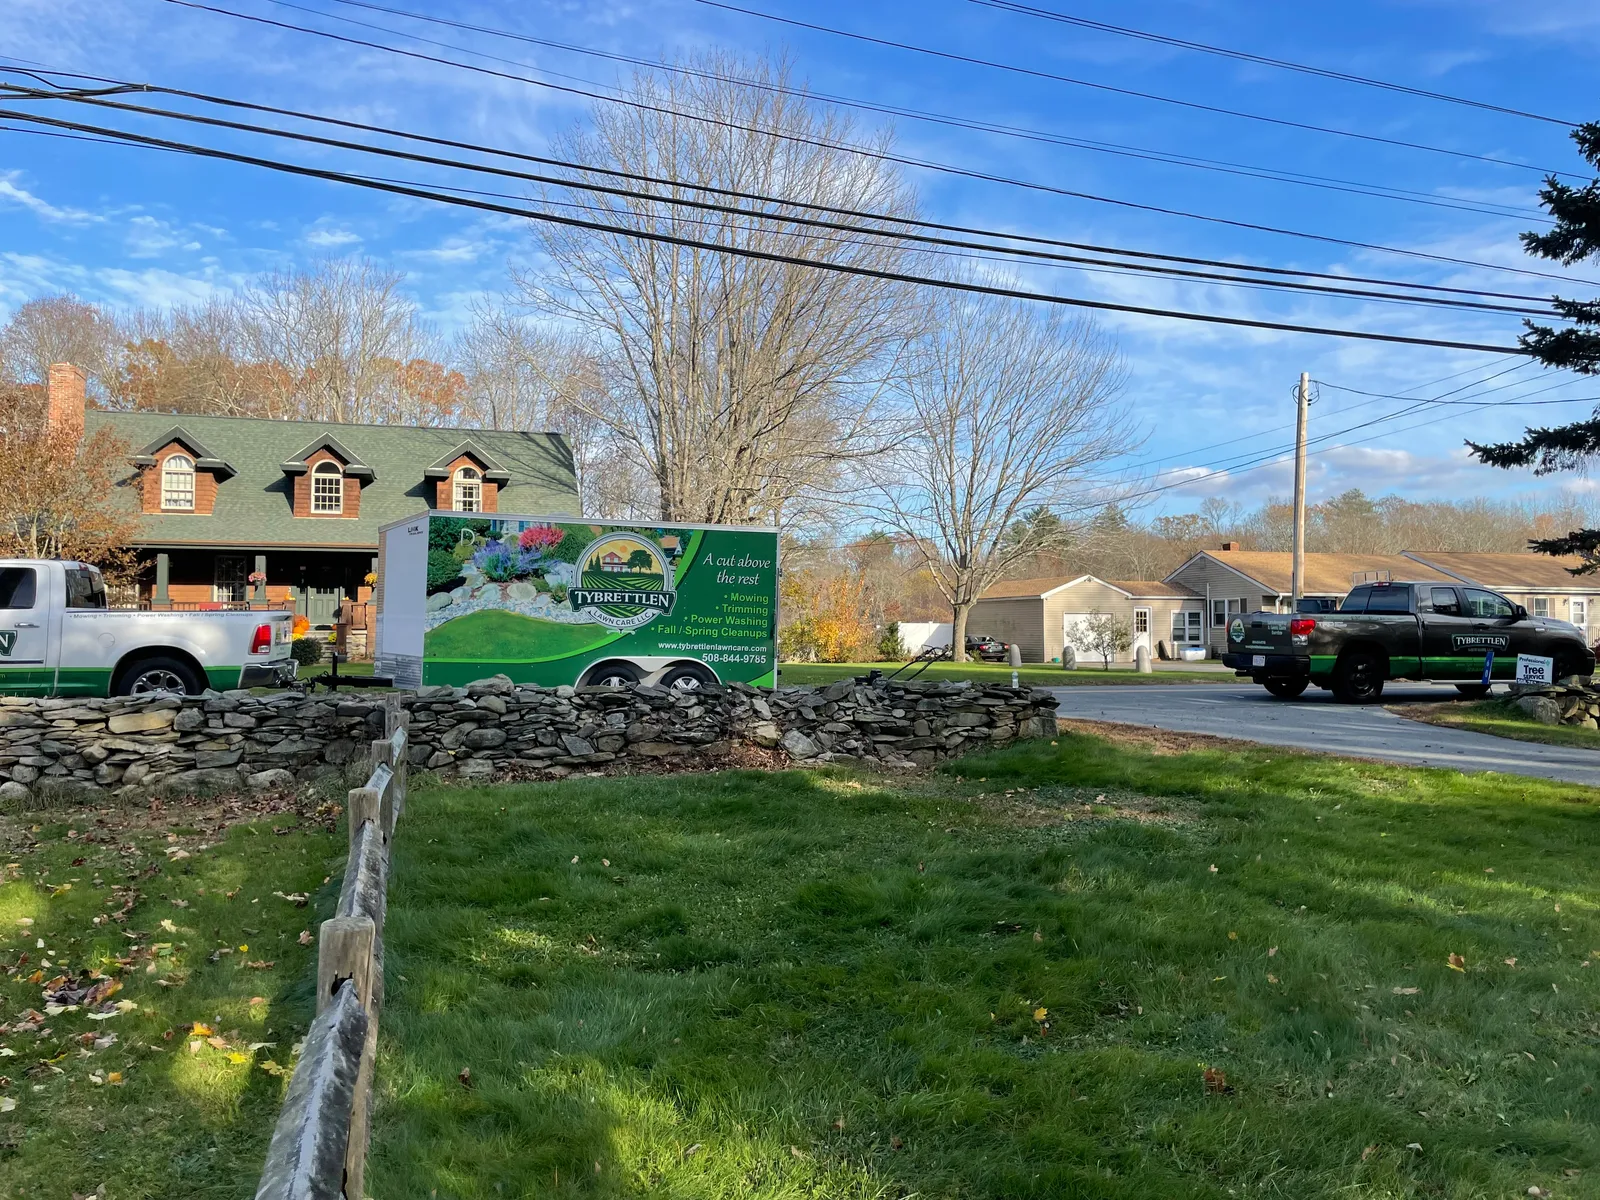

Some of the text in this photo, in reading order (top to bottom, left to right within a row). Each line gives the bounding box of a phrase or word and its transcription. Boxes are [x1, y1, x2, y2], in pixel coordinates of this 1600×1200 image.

[702, 552, 771, 569] A cut above
[716, 569, 760, 585] the rest
[574, 591, 670, 608] TYBRETTLEN
[730, 592, 769, 605] Mowing
[722, 604, 769, 617] Trimming
[593, 610, 615, 626] LAWN
[636, 613, 651, 624] LLC
[690, 614, 768, 628] Power Washing
[657, 624, 676, 634] Fall
[685, 625, 719, 638] Spring
[721, 627, 768, 638] Cleanups
[1455, 636, 1506, 646] TYBRETTLEN
[701, 653, 767, 664] 508-844-9785
[1519, 656, 1546, 664] Professional
[1523, 664, 1545, 675] Tree
